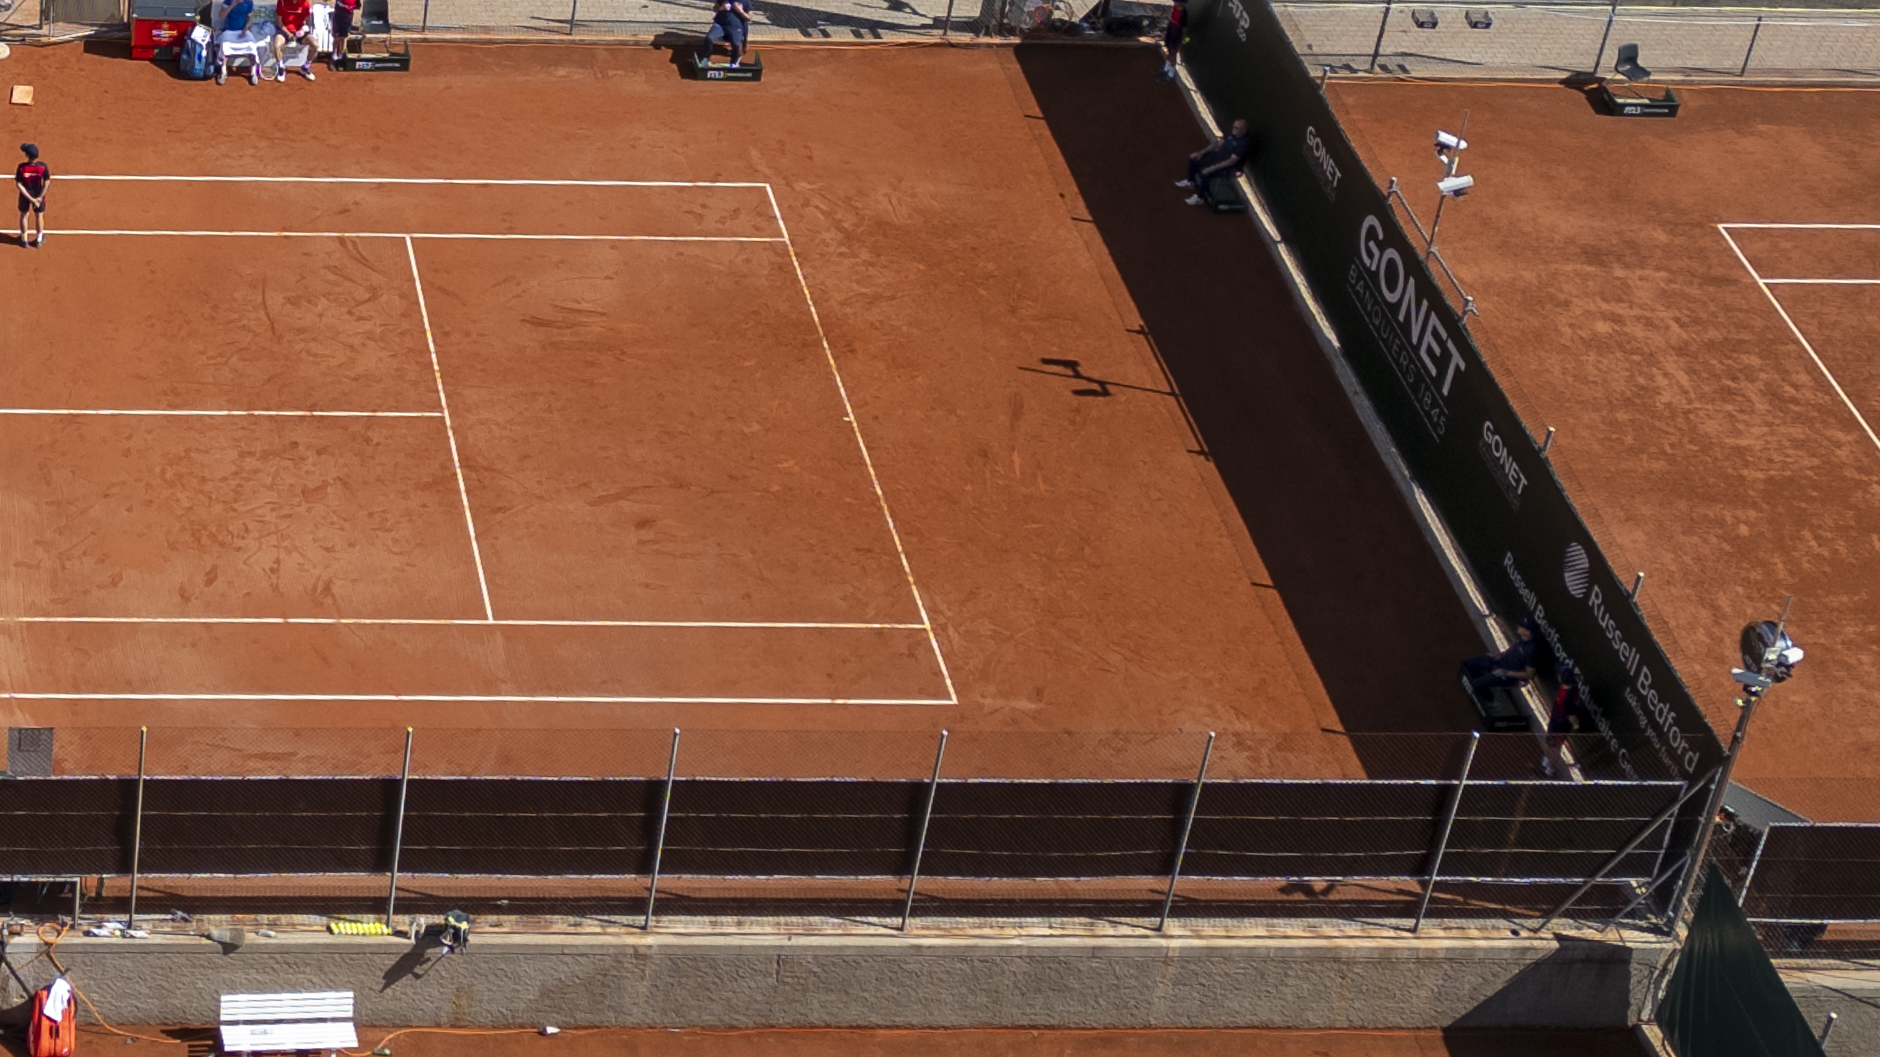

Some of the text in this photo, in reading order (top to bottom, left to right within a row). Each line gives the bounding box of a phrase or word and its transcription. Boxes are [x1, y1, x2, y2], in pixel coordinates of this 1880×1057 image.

[1306, 126, 1342, 188] GONET
[1348, 263, 1446, 435] BANQUIERS 1845
[1360, 215, 1465, 396] GONET
[1483, 421, 1528, 495] GONET
[1504, 551, 1537, 611] Russell
[1588, 584, 1699, 773] Russell Bedford
